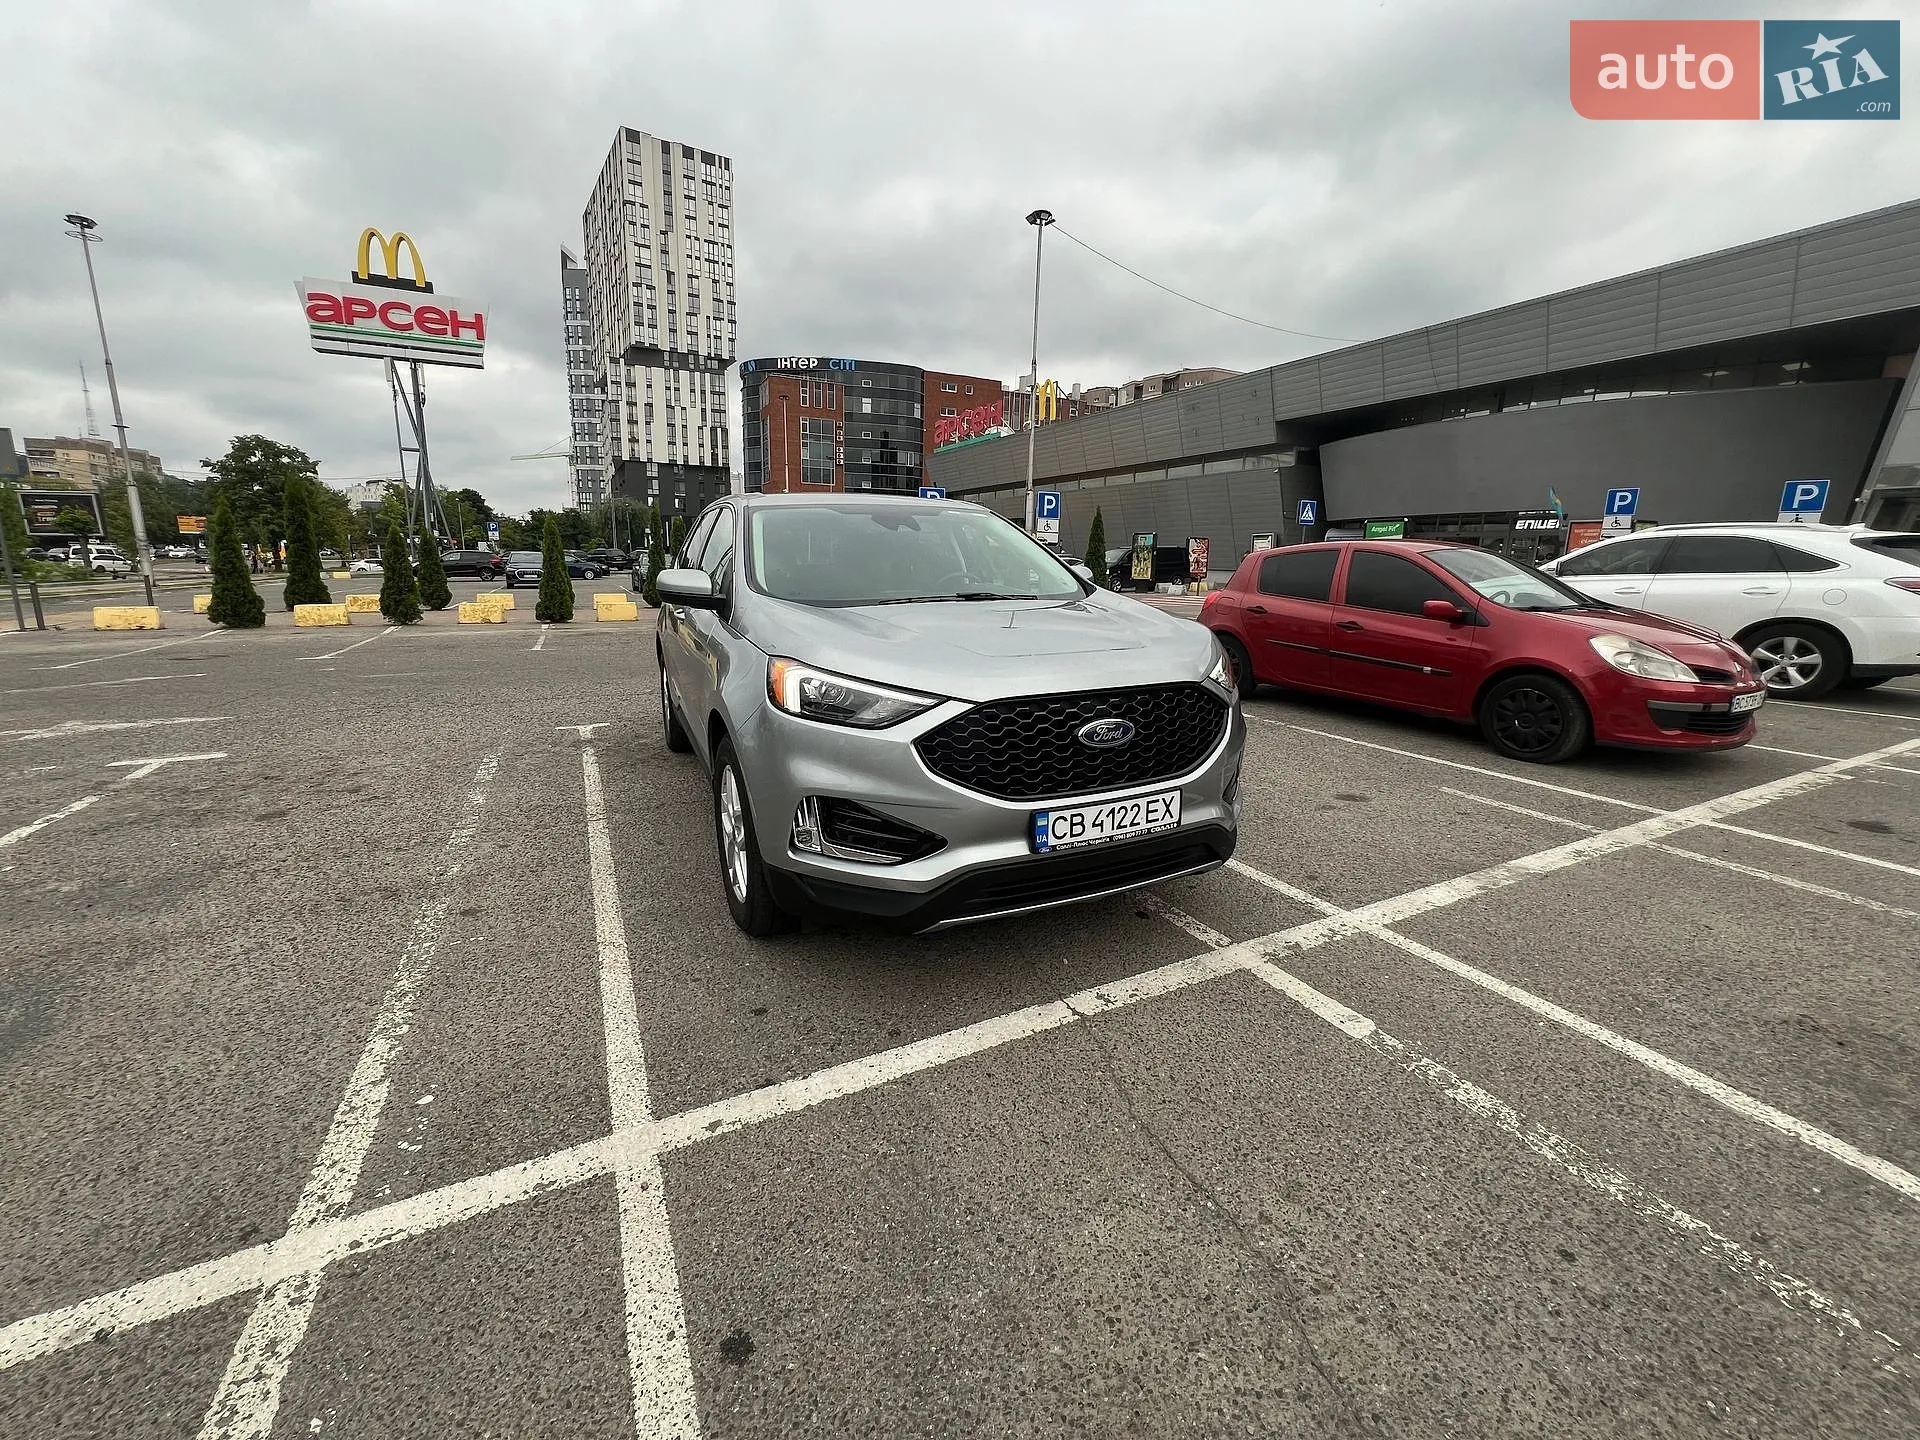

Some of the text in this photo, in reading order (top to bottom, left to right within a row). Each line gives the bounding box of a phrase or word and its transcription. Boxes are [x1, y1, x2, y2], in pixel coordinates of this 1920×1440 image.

[1043, 495, 1056, 516] P
[1612, 491, 1632, 513] P
[1791, 484, 1819, 509] P
[1093, 724, 1123, 742] Ford
[1051, 796, 1175, 841] CB 4122 EX
[1036, 834, 1047, 844] UA
